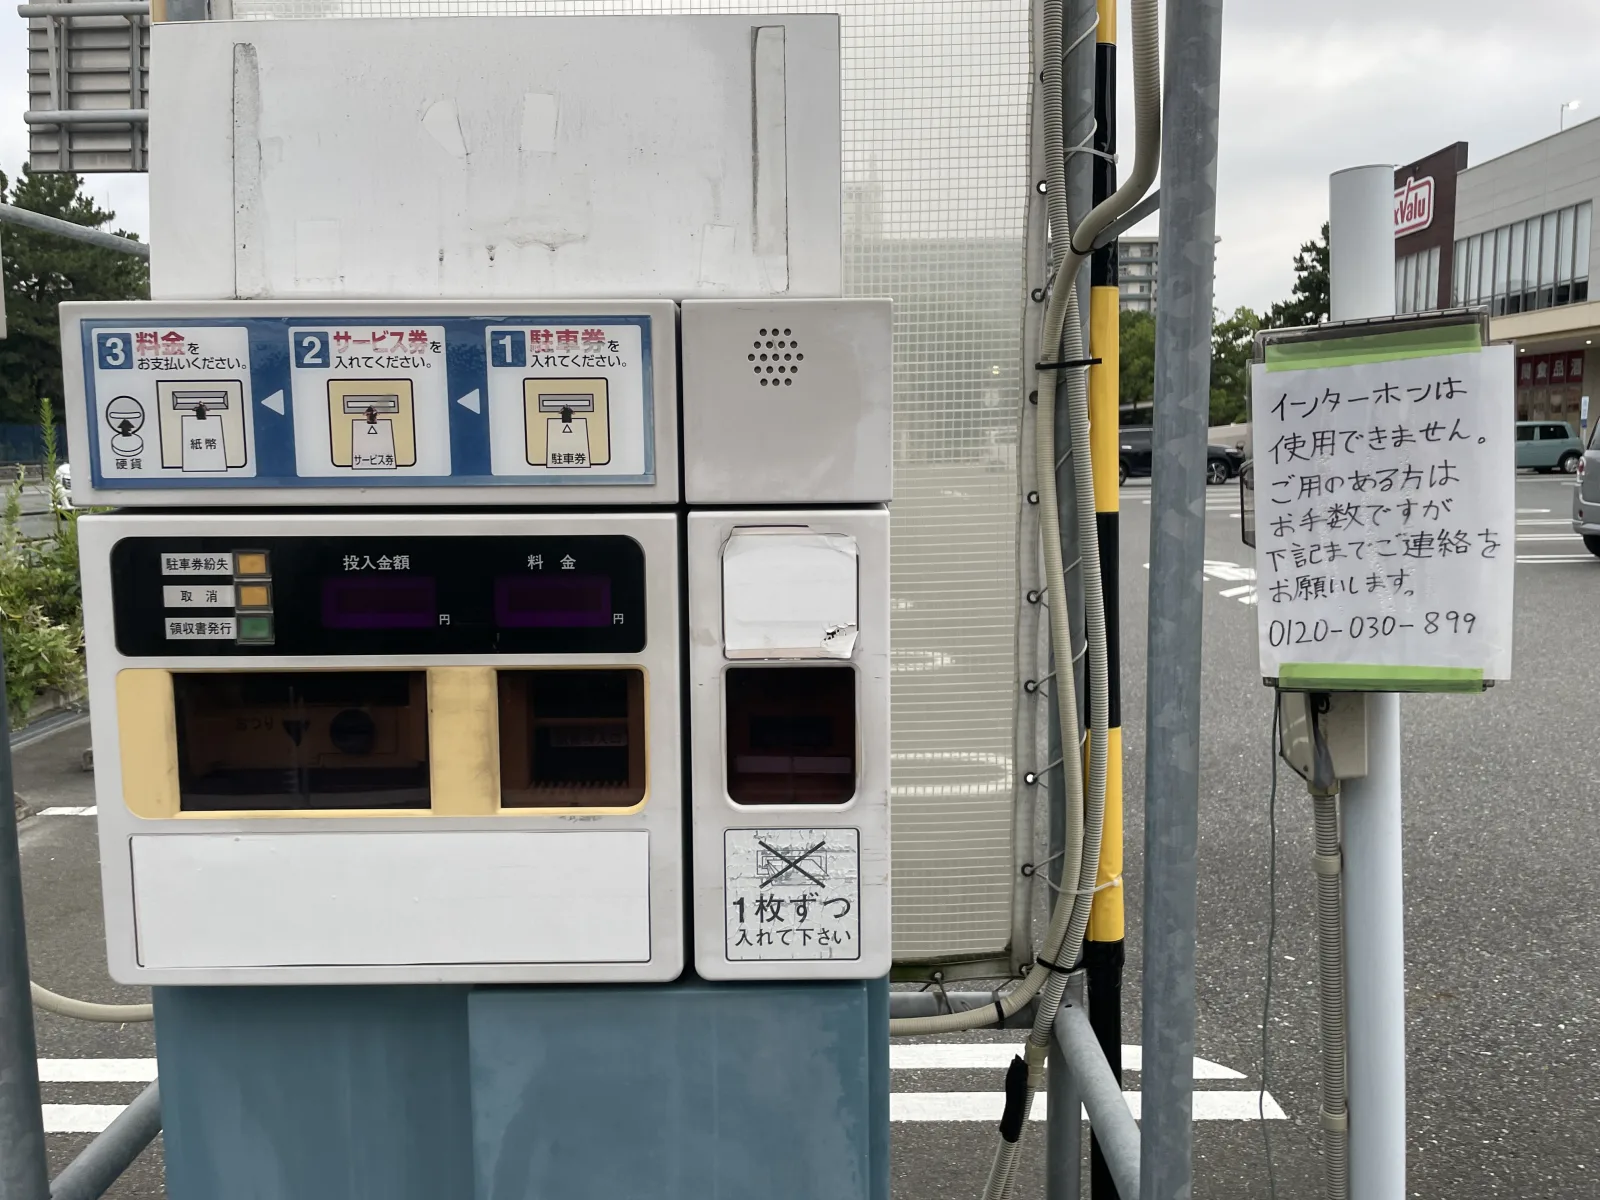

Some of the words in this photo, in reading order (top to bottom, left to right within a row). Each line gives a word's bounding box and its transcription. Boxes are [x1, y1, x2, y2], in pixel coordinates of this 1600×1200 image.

[105, 336, 127, 367] 3
[135, 331, 200, 356] 料金を
[301, 335, 323, 365] 2
[333, 329, 442, 355] サービス券を
[497, 334, 513, 363] 1
[529, 329, 620, 354] 駐車券を
[137, 356, 248, 371] お支払いください。
[334, 355, 432, 369] 入れてください。
[530, 353, 628, 369] 入れてください。
[1270, 376, 1468, 421] インターホンは
[190, 438, 217, 451] 紙幣
[1267, 418, 1487, 465] 使用できません。
[115, 458, 143, 471] 硬貨
[354, 454, 394, 466] サービス券
[551, 452, 587, 465] 駐車券
[1271, 459, 1460, 504] ご用のある方は
[1270, 497, 1453, 537] お手数ですが
[343, 554, 411, 571] 投入金額
[1266, 528, 1501, 572] 下記までご連絡を
[166, 557, 229, 571] 駐車券紛失
[1269, 568, 1415, 603] お願いします。
[169, 621, 233, 636] 領収書発行
[438, 613, 451, 626] 円
[612, 613, 625, 625] 円
[1269, 610, 1477, 647] 0120-030-899
[732, 891, 852, 924] 1枚ずつ
[734, 927, 852, 947] 入れて下さい
